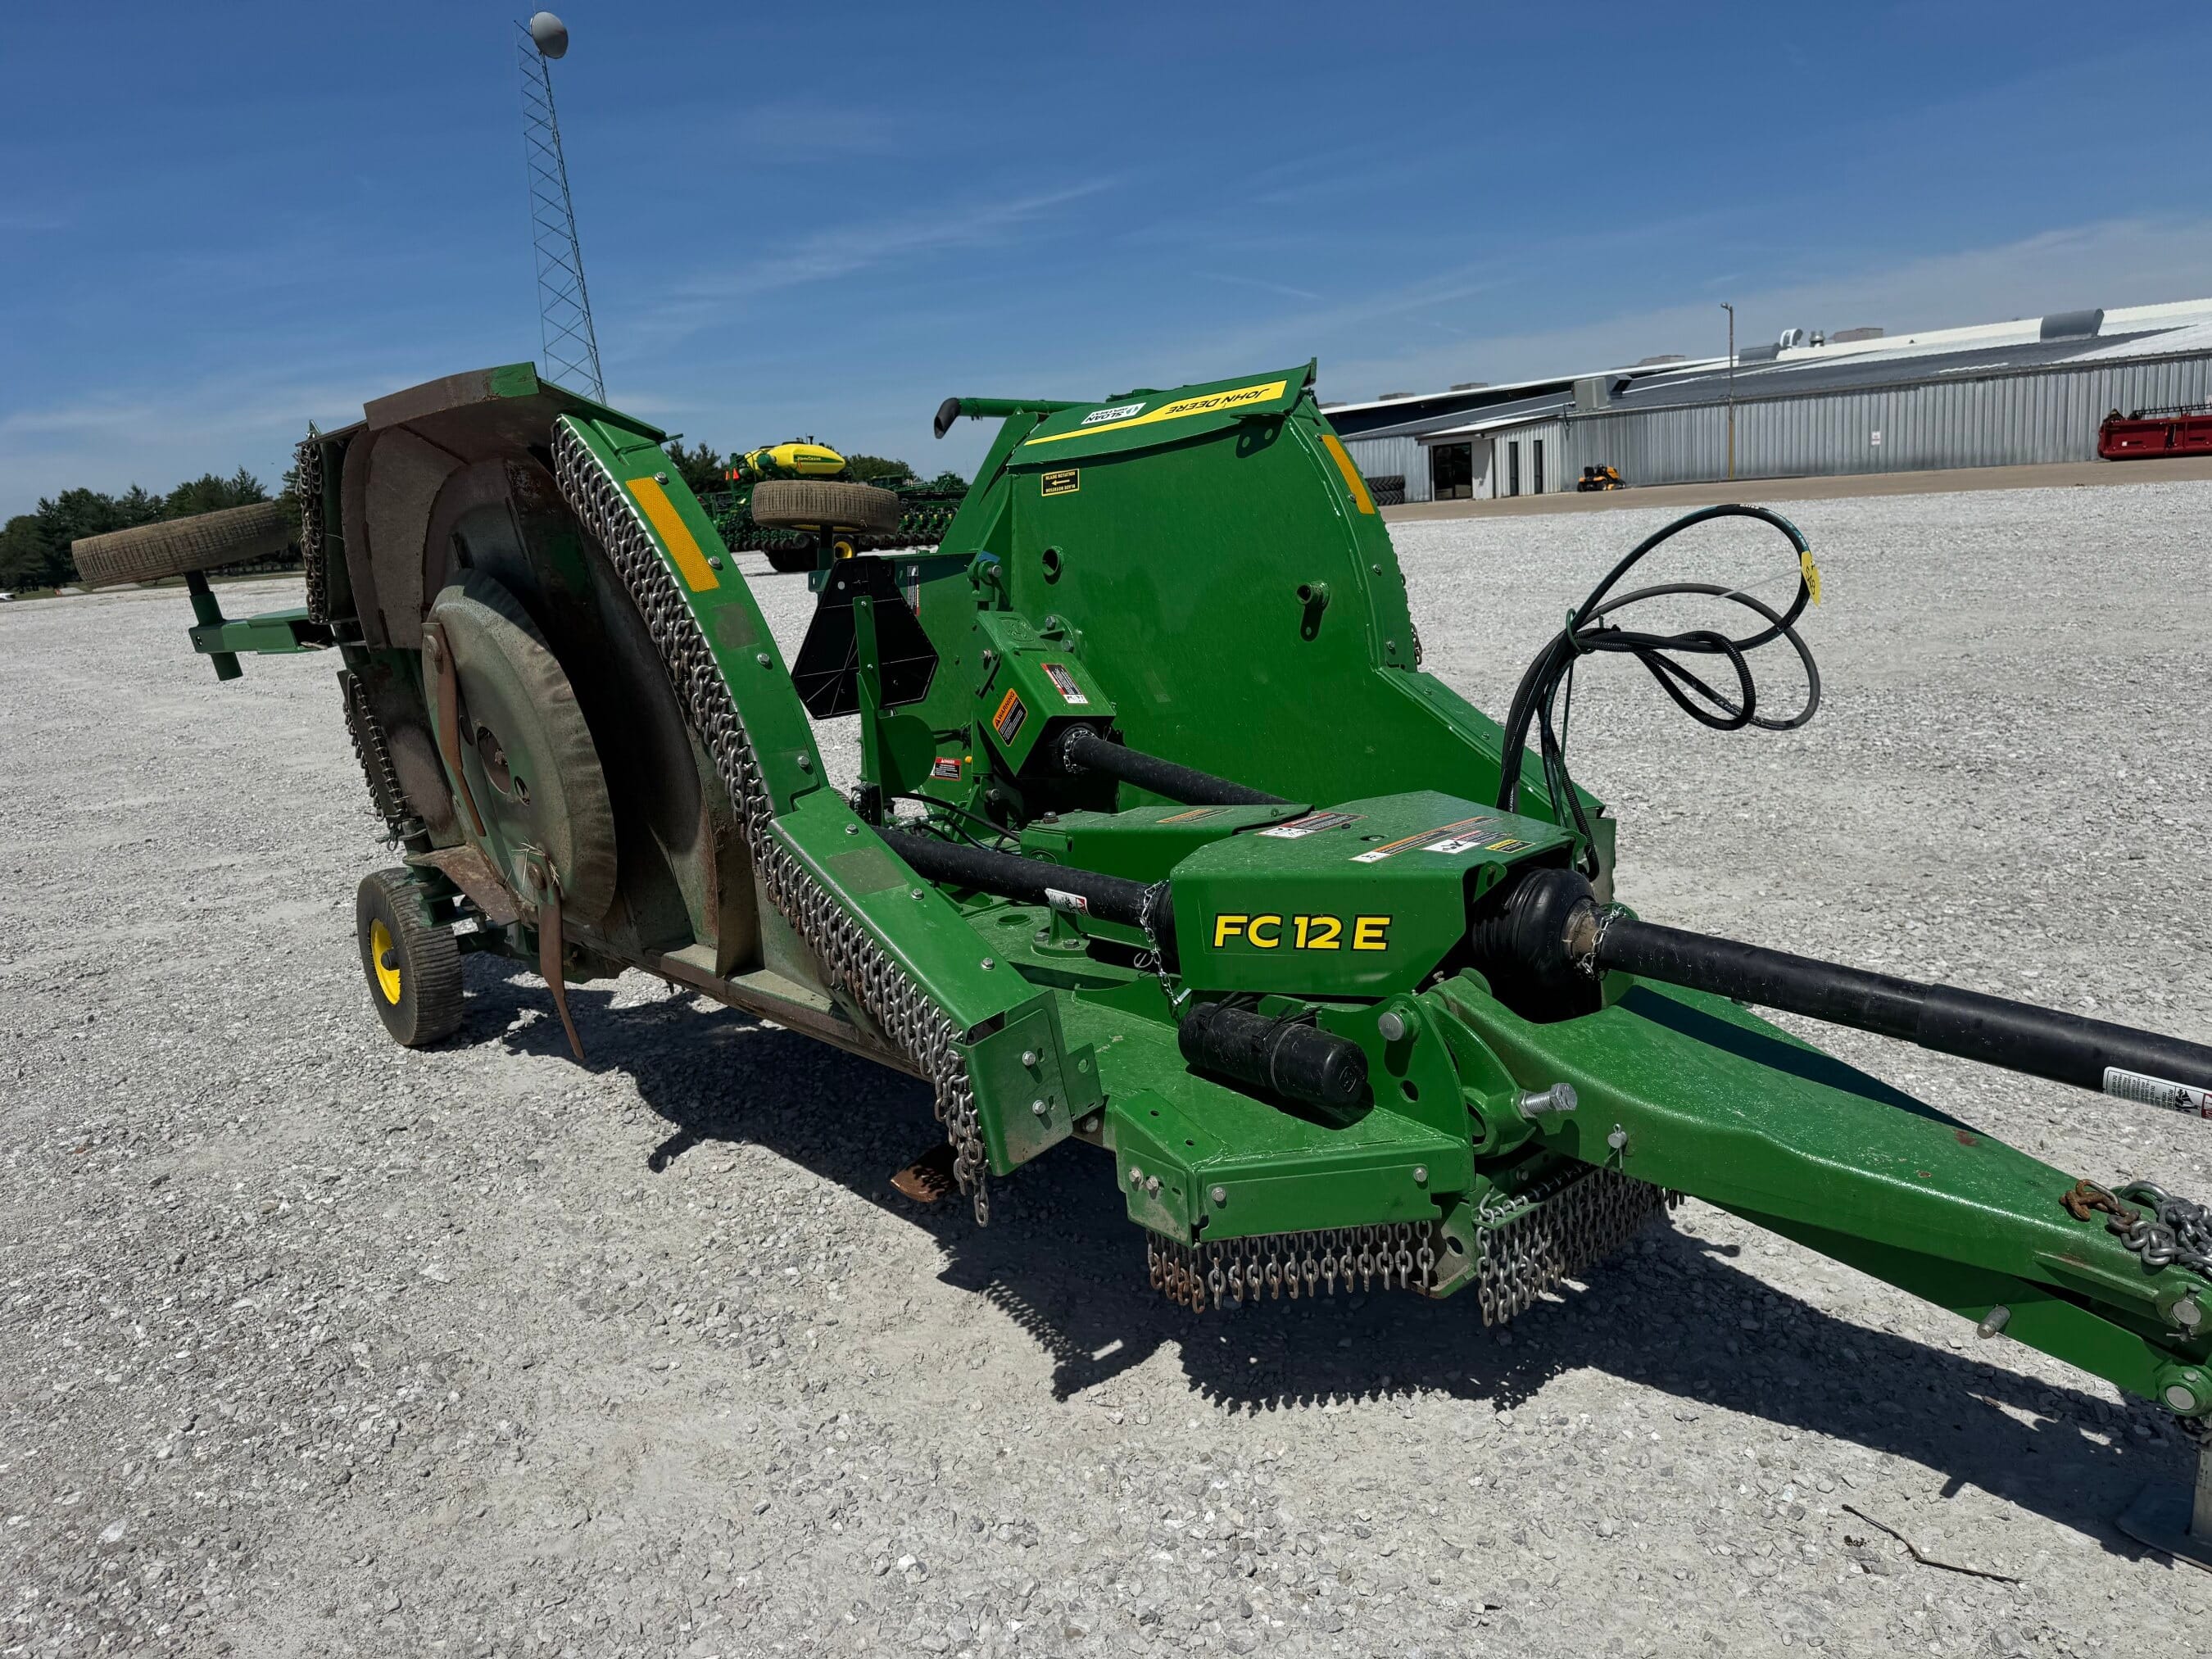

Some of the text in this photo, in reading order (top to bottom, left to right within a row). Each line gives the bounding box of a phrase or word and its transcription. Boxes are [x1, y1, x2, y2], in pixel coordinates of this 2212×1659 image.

[1164, 388, 1271, 415] JOHN DEERE
[1085, 410, 1125, 422] SLOAN
[998, 691, 1015, 721] WARNING
[1213, 913, 1393, 951] FC 12 E
